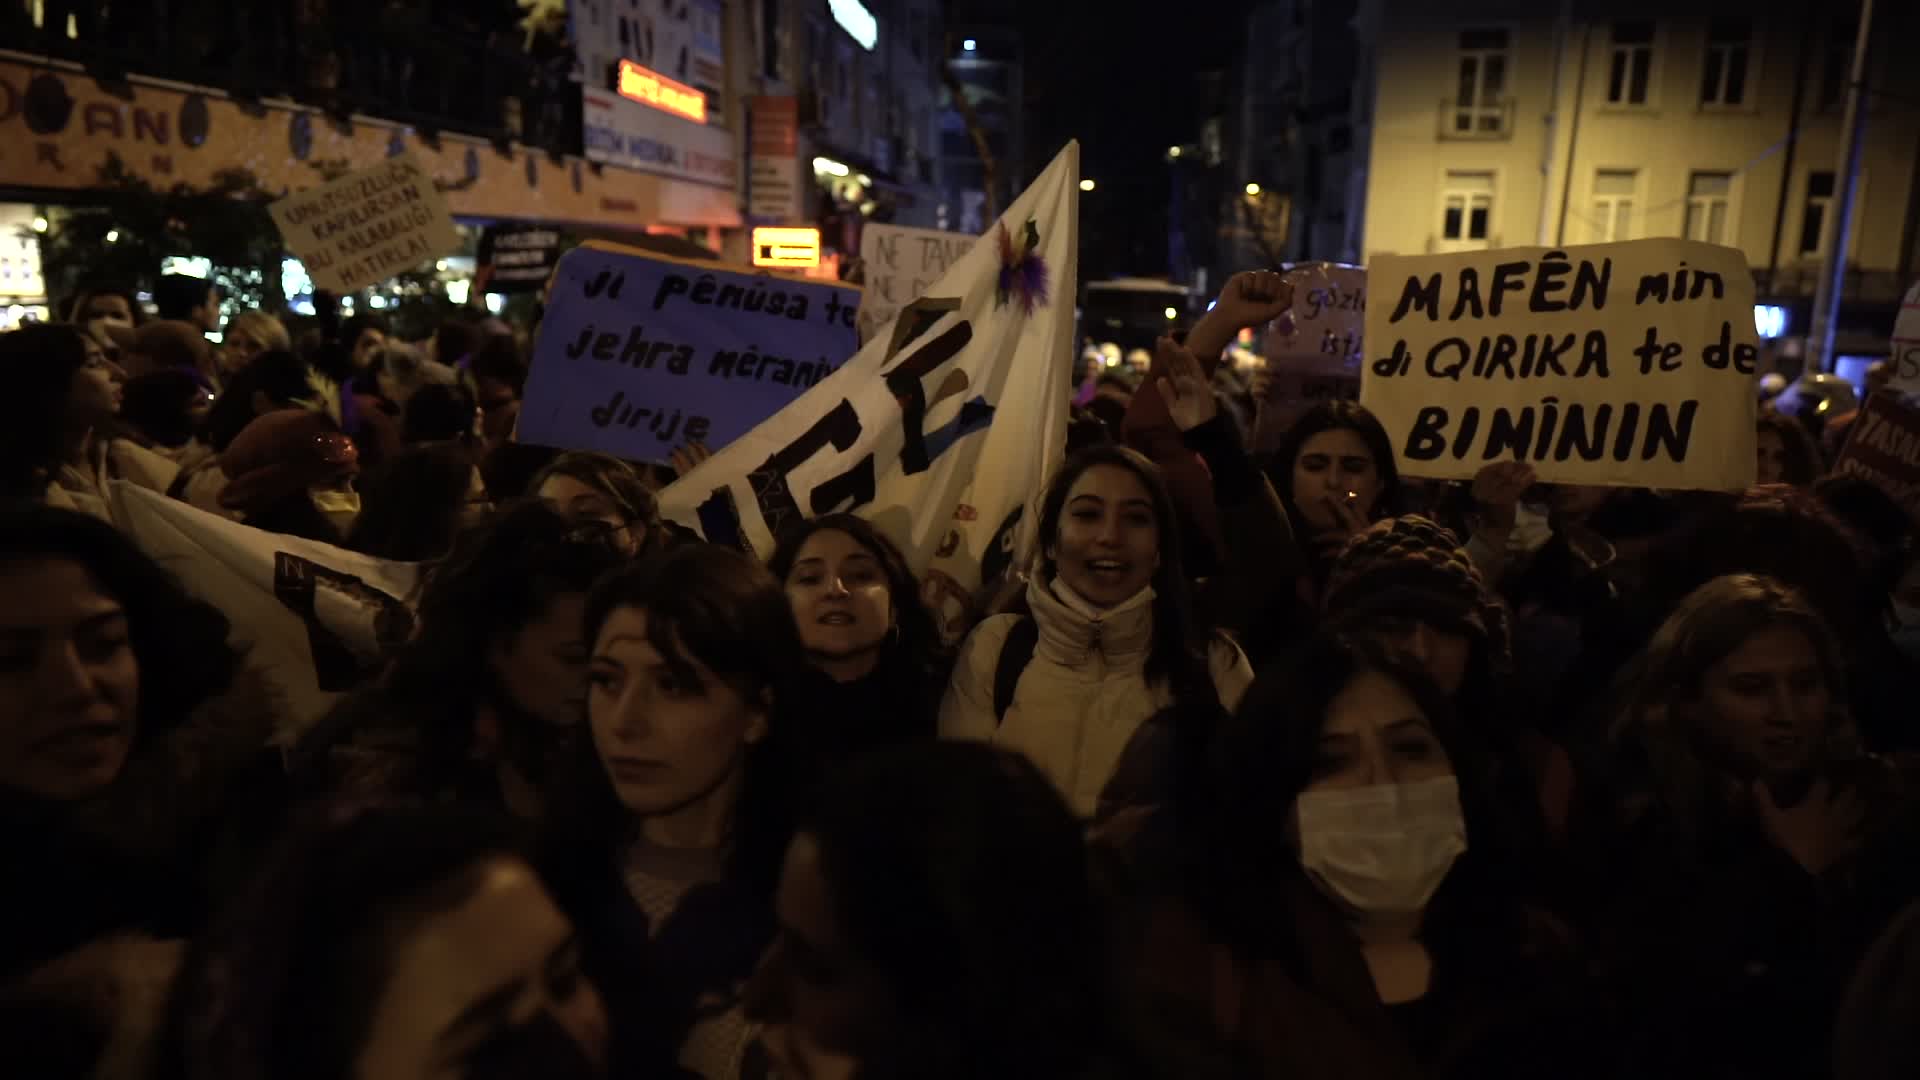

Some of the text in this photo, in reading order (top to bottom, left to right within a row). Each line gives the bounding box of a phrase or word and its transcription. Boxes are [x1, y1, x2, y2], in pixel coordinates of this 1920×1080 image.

[304, 248, 333, 272] BU
[875, 233, 905, 269] NE
[1389, 251, 1724, 324] MAFÊN min
[1372, 321, 1757, 381] di QIRIKA te de
[1404, 397, 1698, 462] BIMÎNIN
